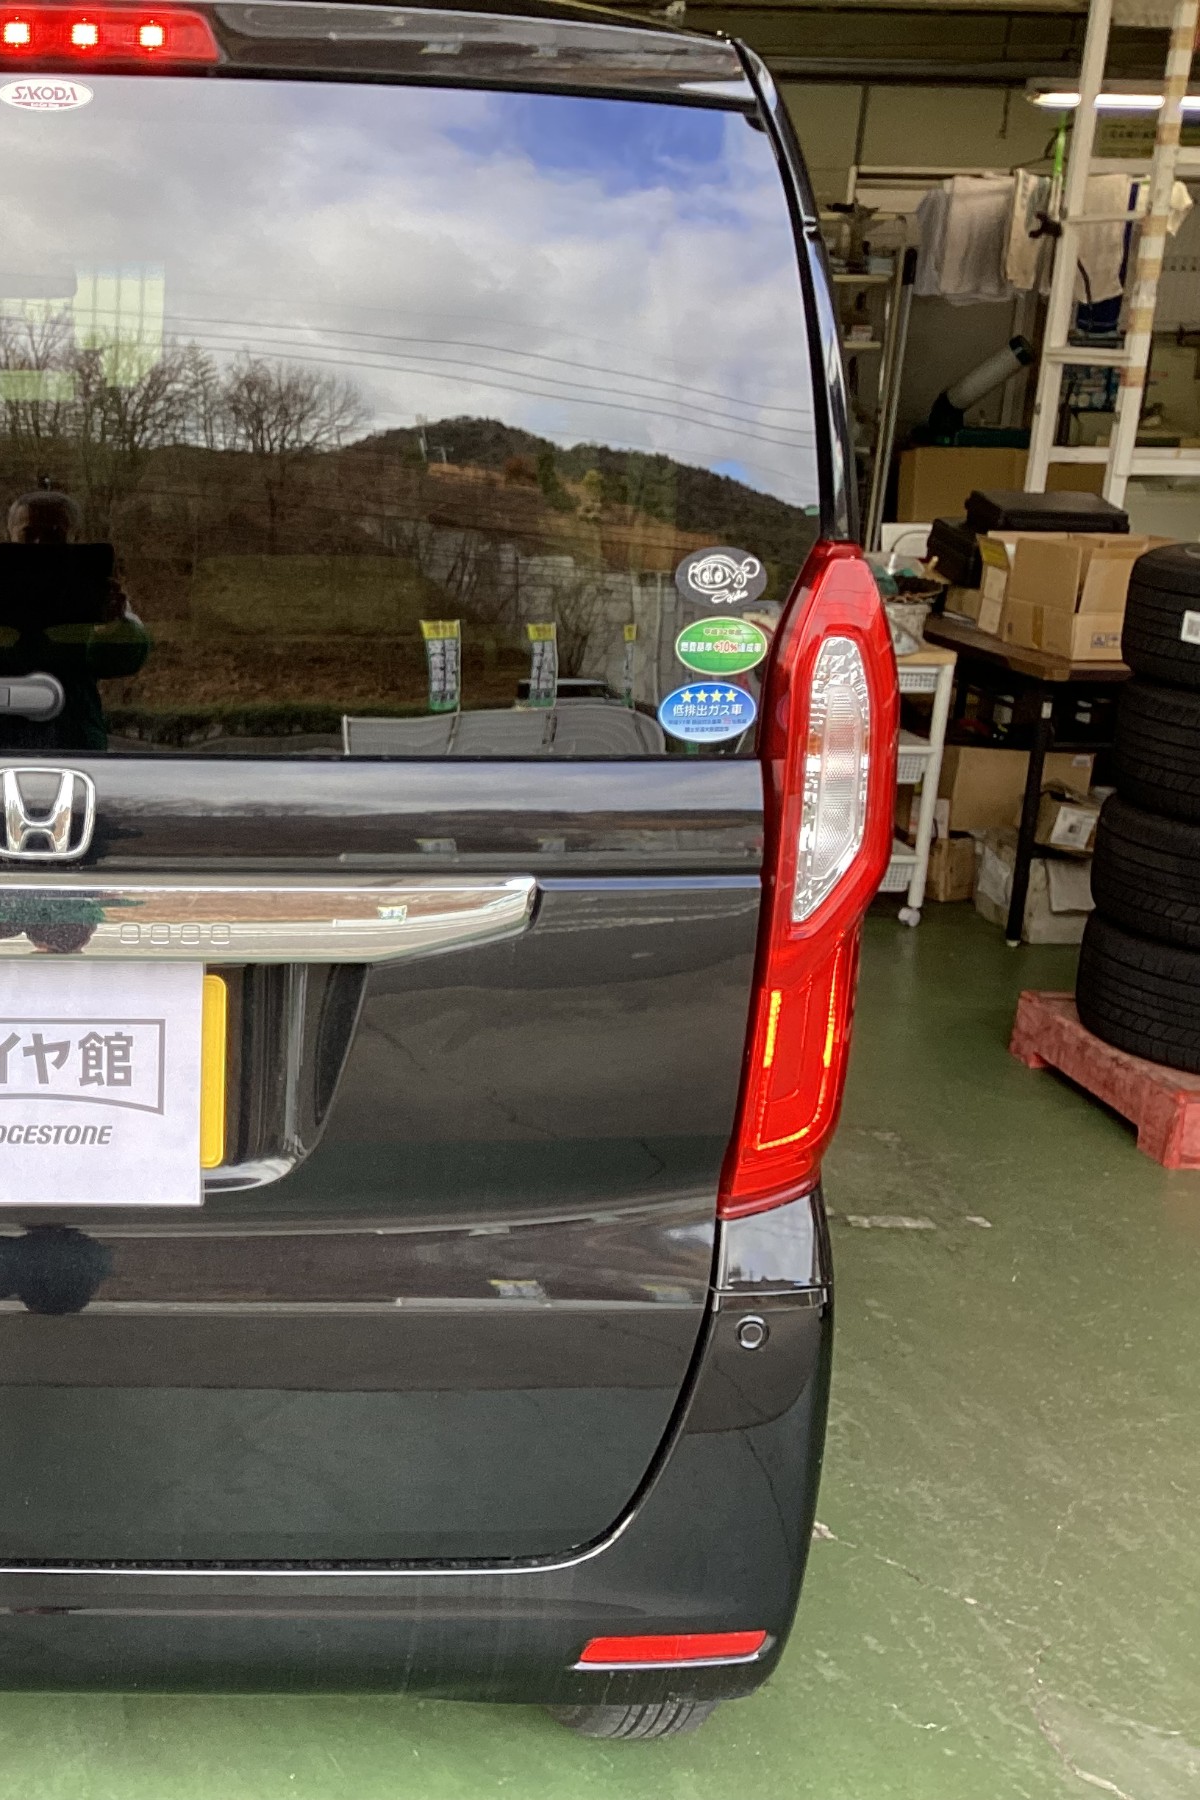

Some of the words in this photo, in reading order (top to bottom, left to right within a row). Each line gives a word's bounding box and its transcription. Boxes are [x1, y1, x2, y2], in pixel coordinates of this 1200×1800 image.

[673, 703, 743, 717] 低排出ガス車
